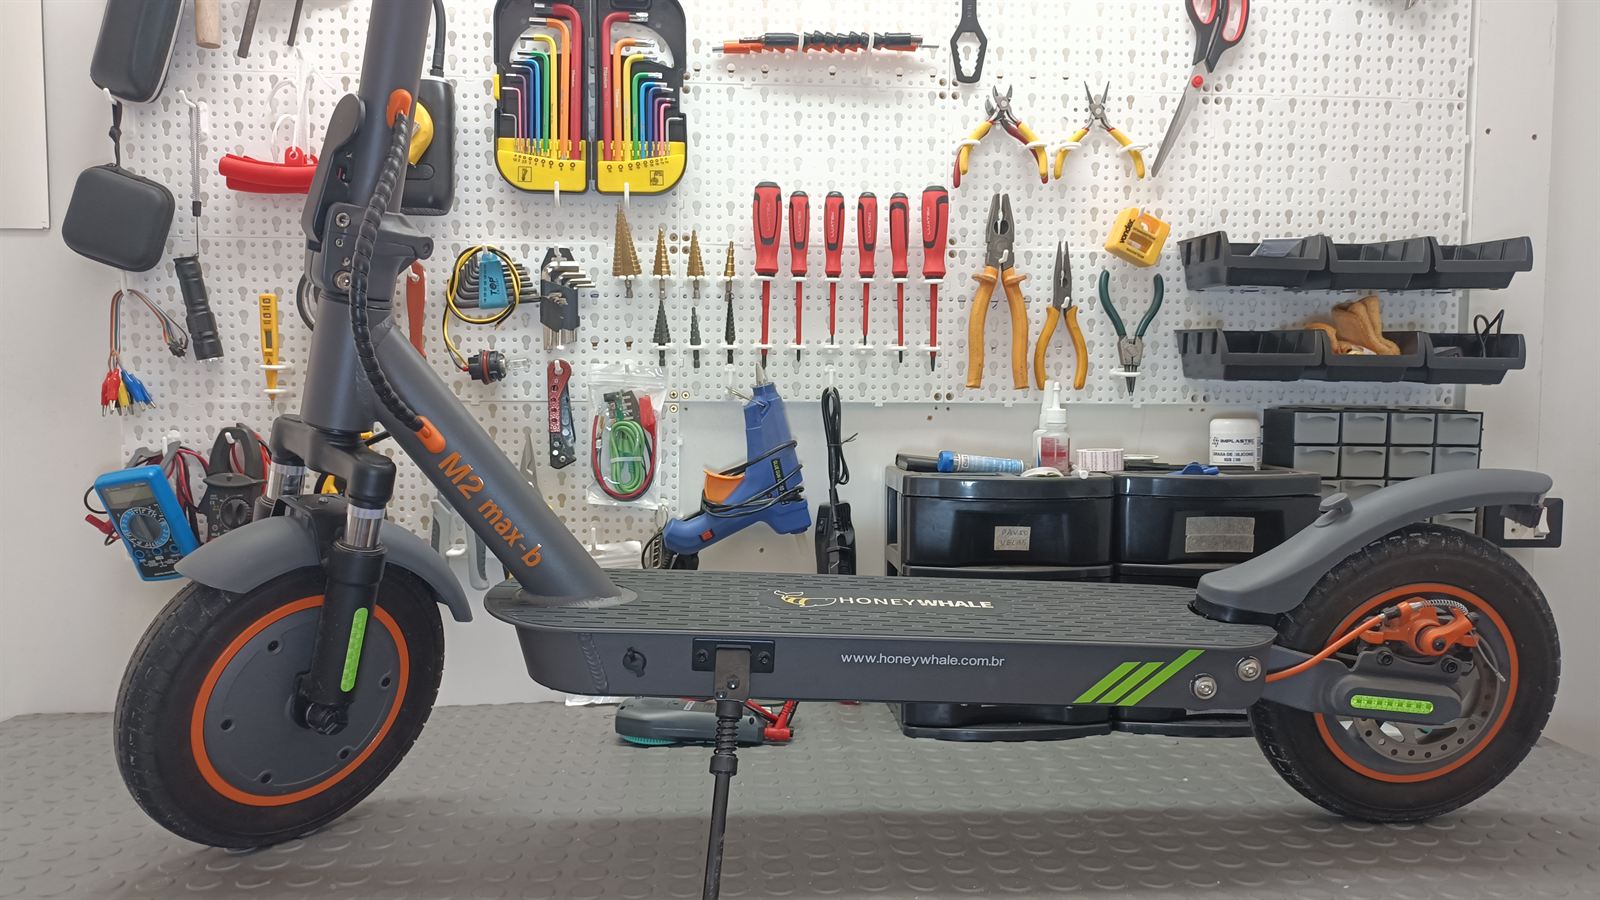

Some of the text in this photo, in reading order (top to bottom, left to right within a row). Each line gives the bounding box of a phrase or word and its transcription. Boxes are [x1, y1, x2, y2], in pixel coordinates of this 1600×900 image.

[438, 451, 543, 568] M2 max-b
[840, 596, 994, 609] HONEYWHALE
[841, 652, 1005, 668] www.honeywhale.com.br
